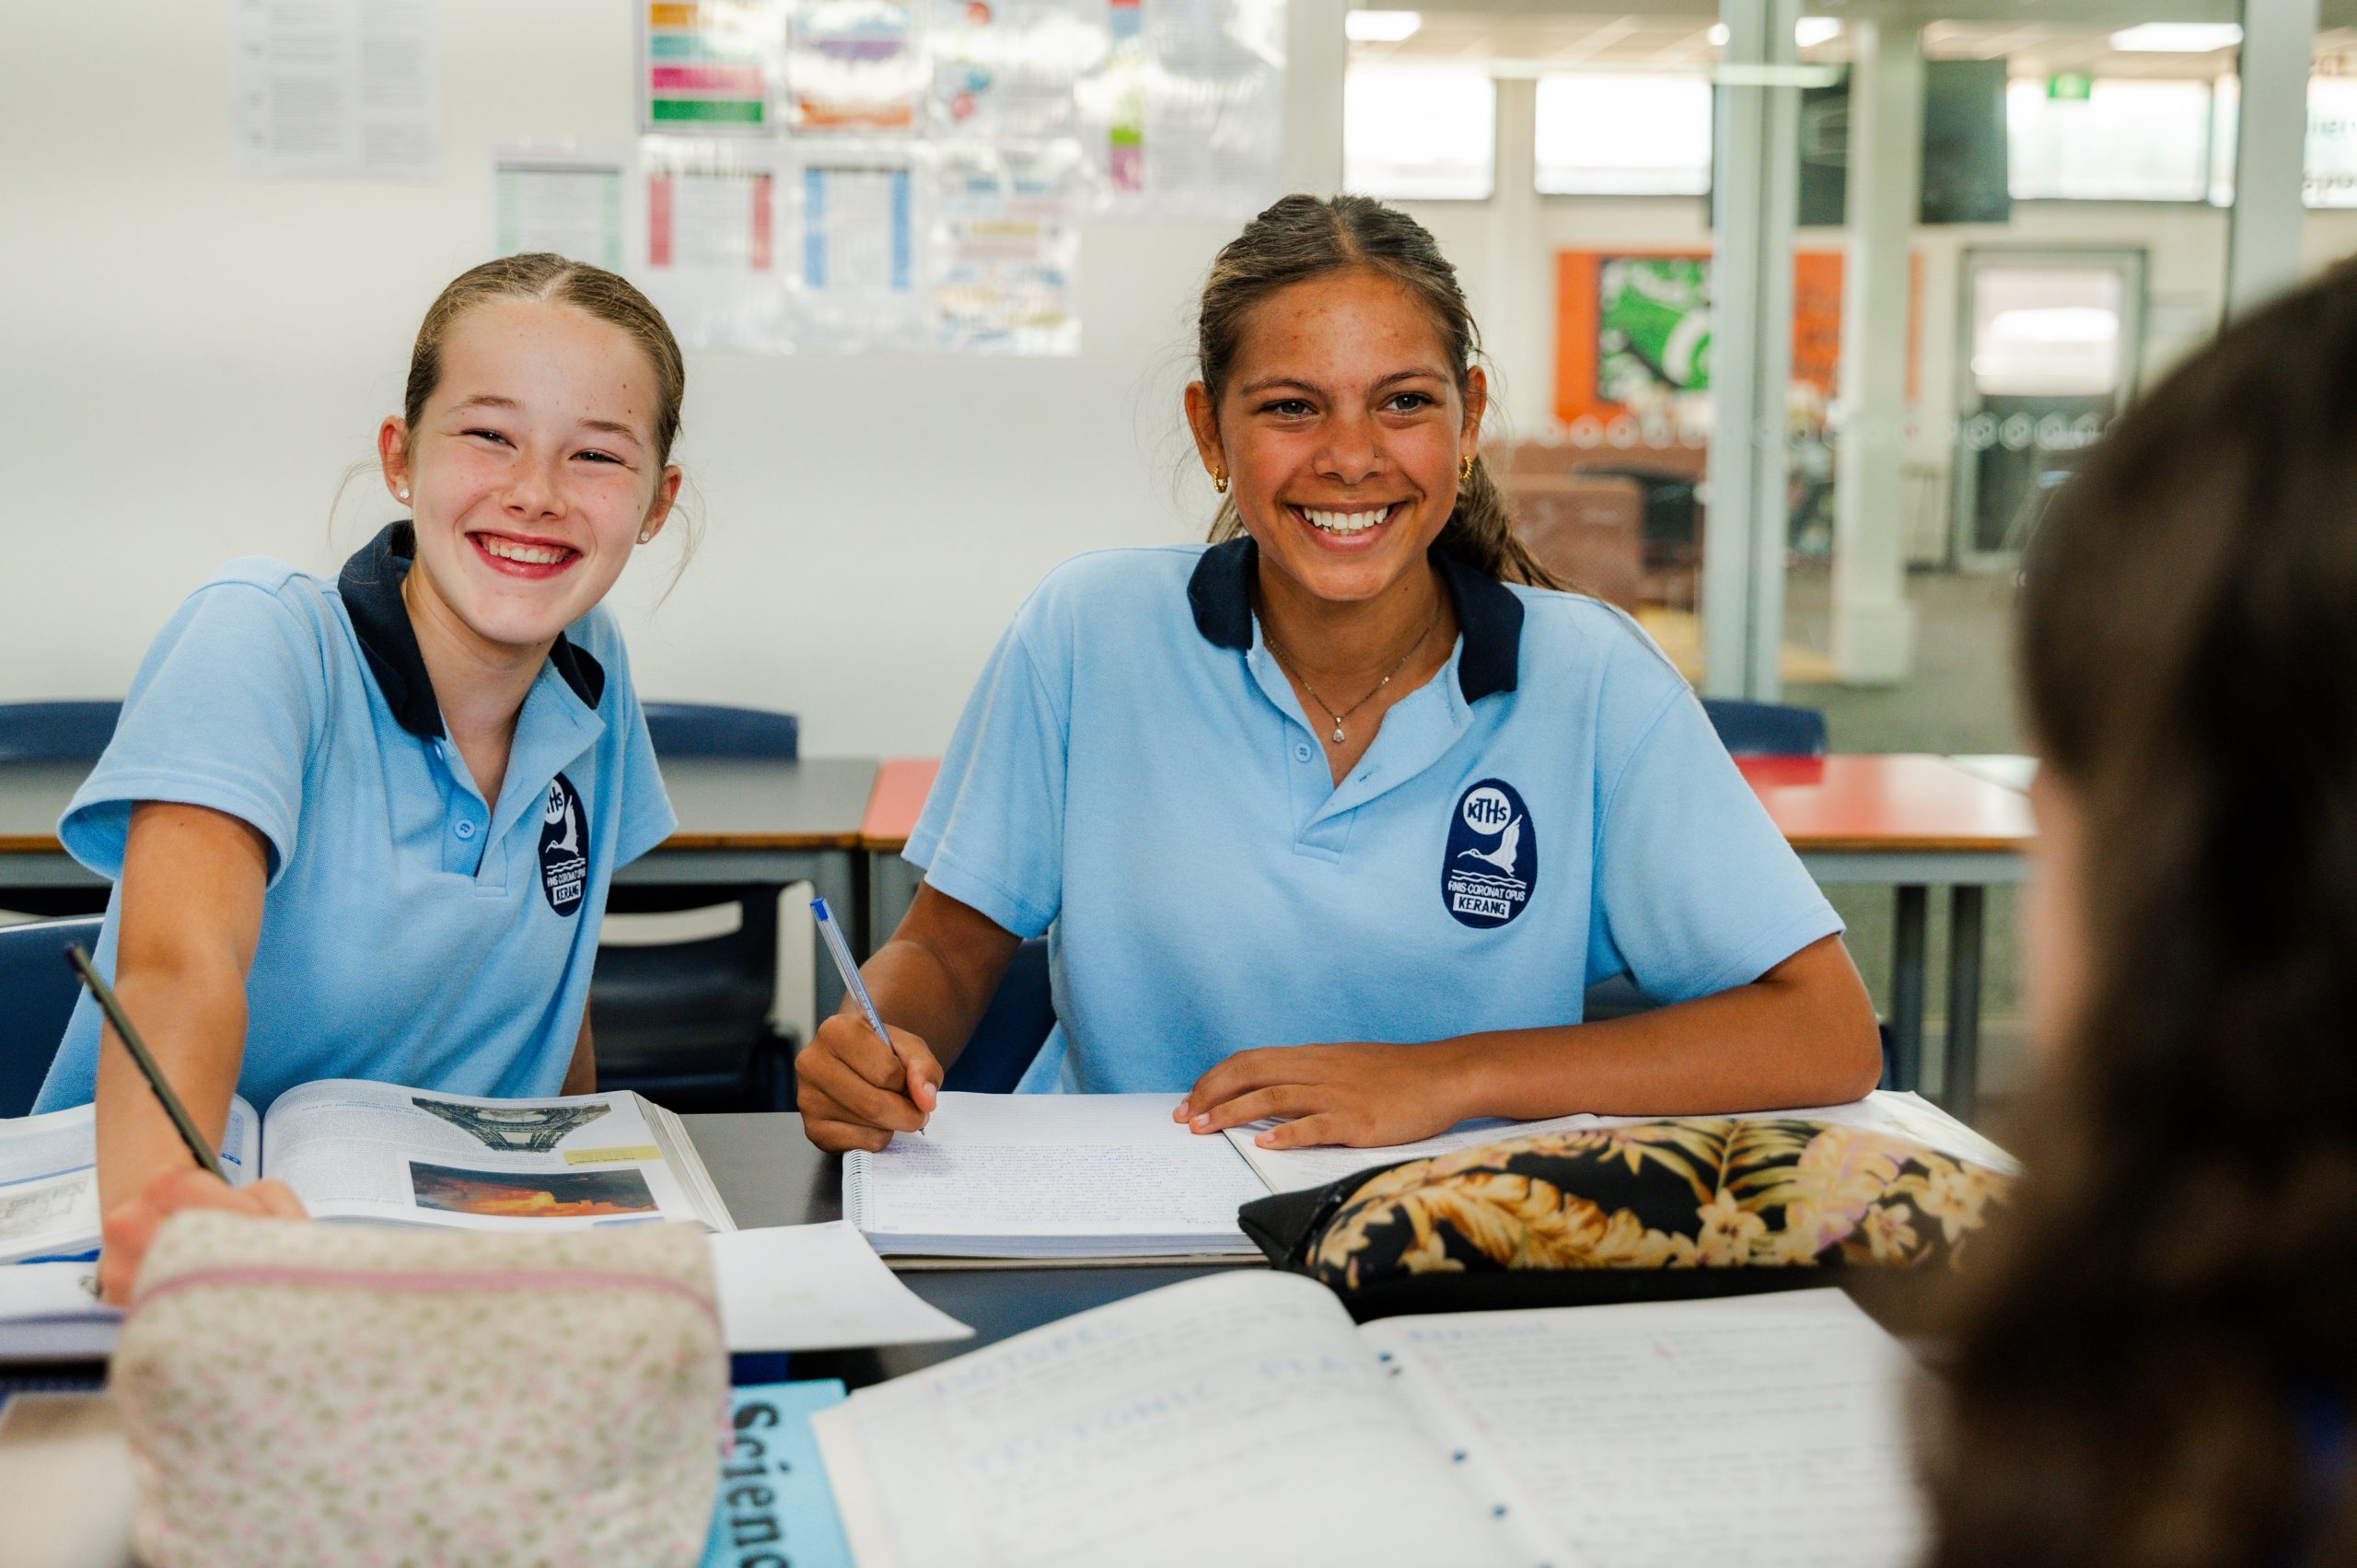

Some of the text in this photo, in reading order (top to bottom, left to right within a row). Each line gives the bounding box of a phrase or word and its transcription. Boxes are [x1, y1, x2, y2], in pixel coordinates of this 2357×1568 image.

[556, 884, 579, 901] KERANG
[1448, 880, 1526, 901] FINIS CORONAT OPUS
[1458, 896, 1506, 915] KERANG
